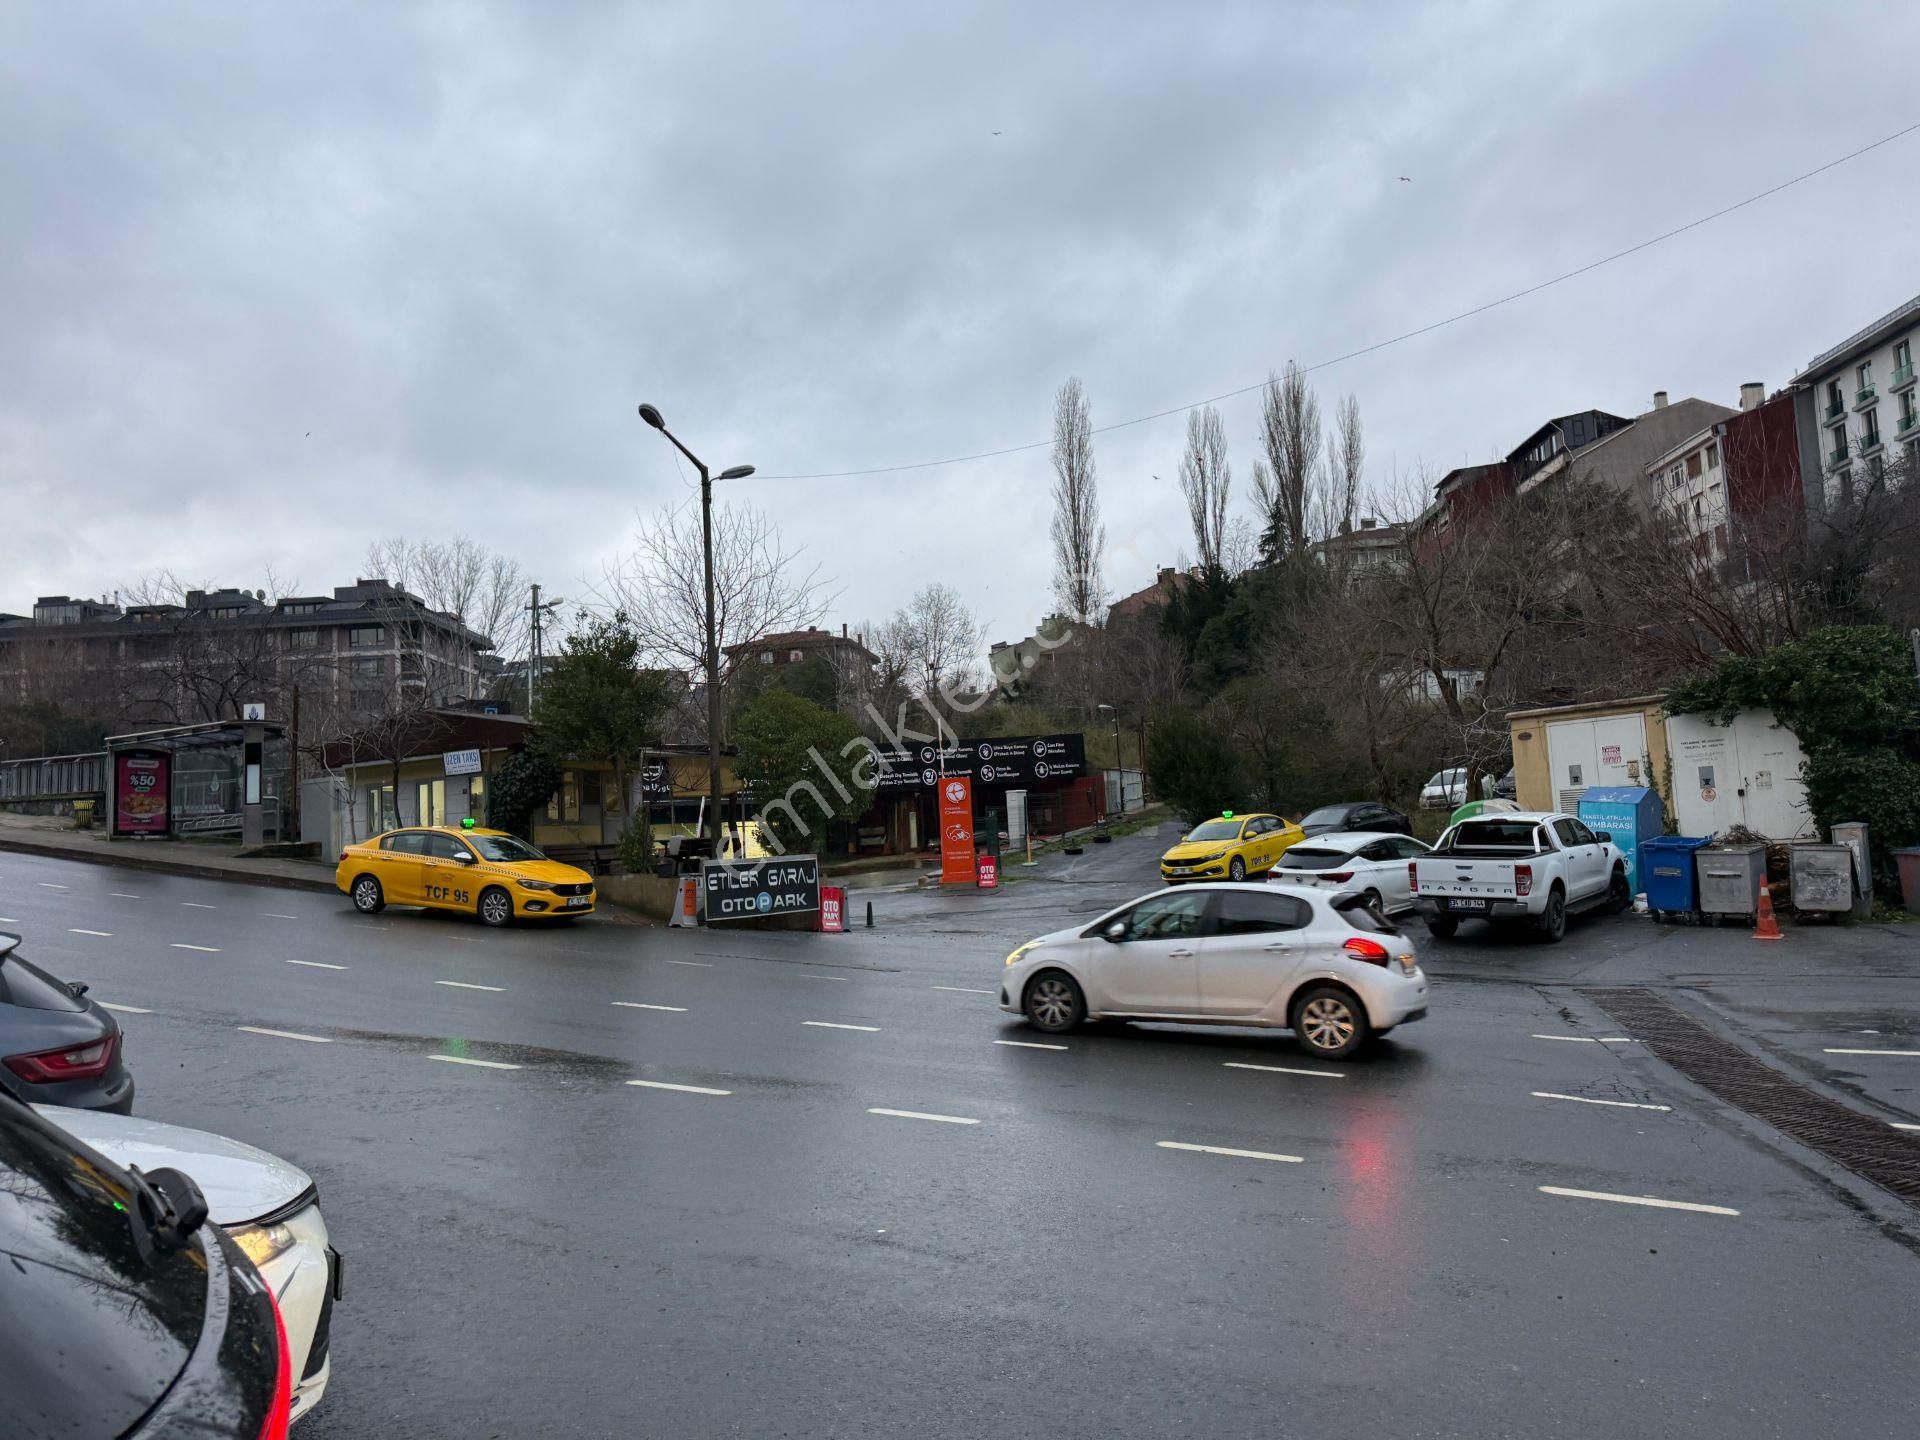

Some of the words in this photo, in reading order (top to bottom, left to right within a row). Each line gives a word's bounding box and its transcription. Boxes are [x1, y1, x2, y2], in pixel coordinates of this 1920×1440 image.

[129, 775, 156, 786] %50
[980, 865, 994, 874] OTO
[767, 867, 816, 886] GARAJ
[425, 885, 450, 900] TCF
[454, 889, 469, 904] 95
[1421, 885, 1513, 894] RANGER
[823, 900, 839, 911] OTO
[823, 912, 839, 920] PARK
